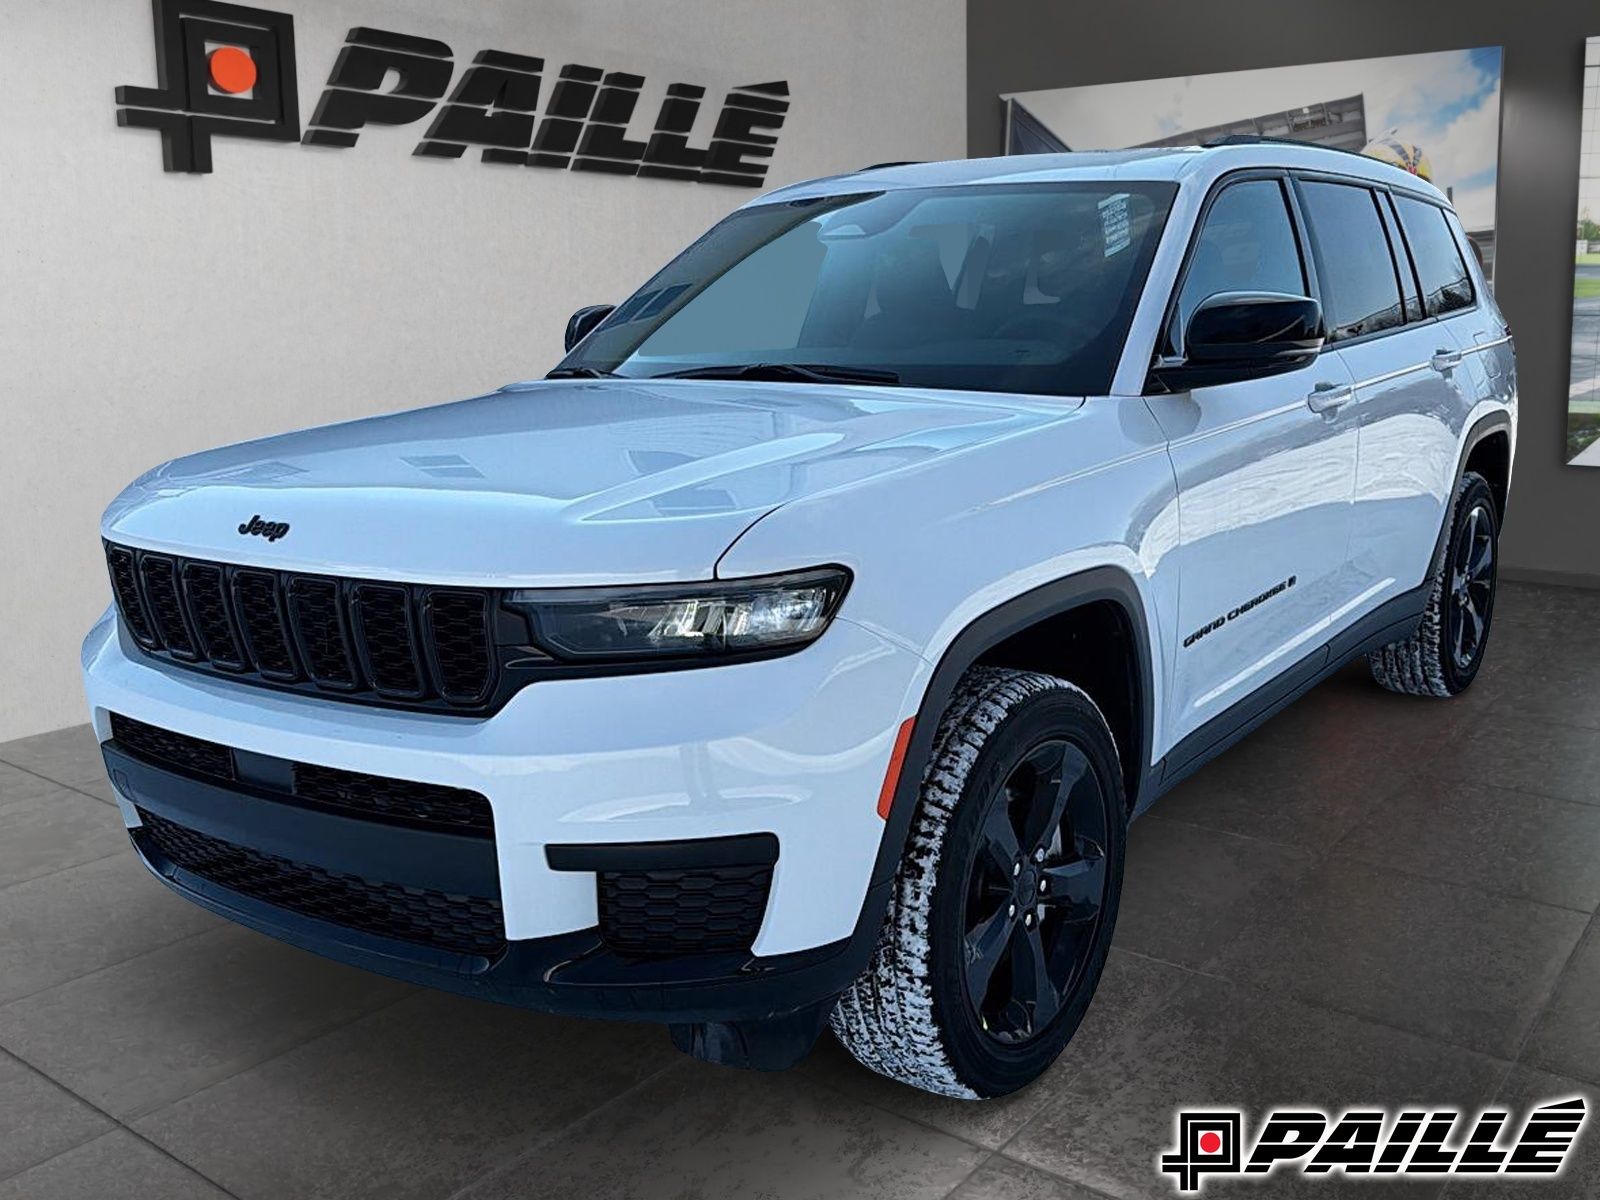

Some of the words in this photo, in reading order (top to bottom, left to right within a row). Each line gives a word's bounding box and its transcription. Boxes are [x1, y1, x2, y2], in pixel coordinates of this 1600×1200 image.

[301, 26, 790, 188] PAILLÉ
[238, 514, 290, 542] Jeep
[1183, 616, 1226, 648] GRAND
